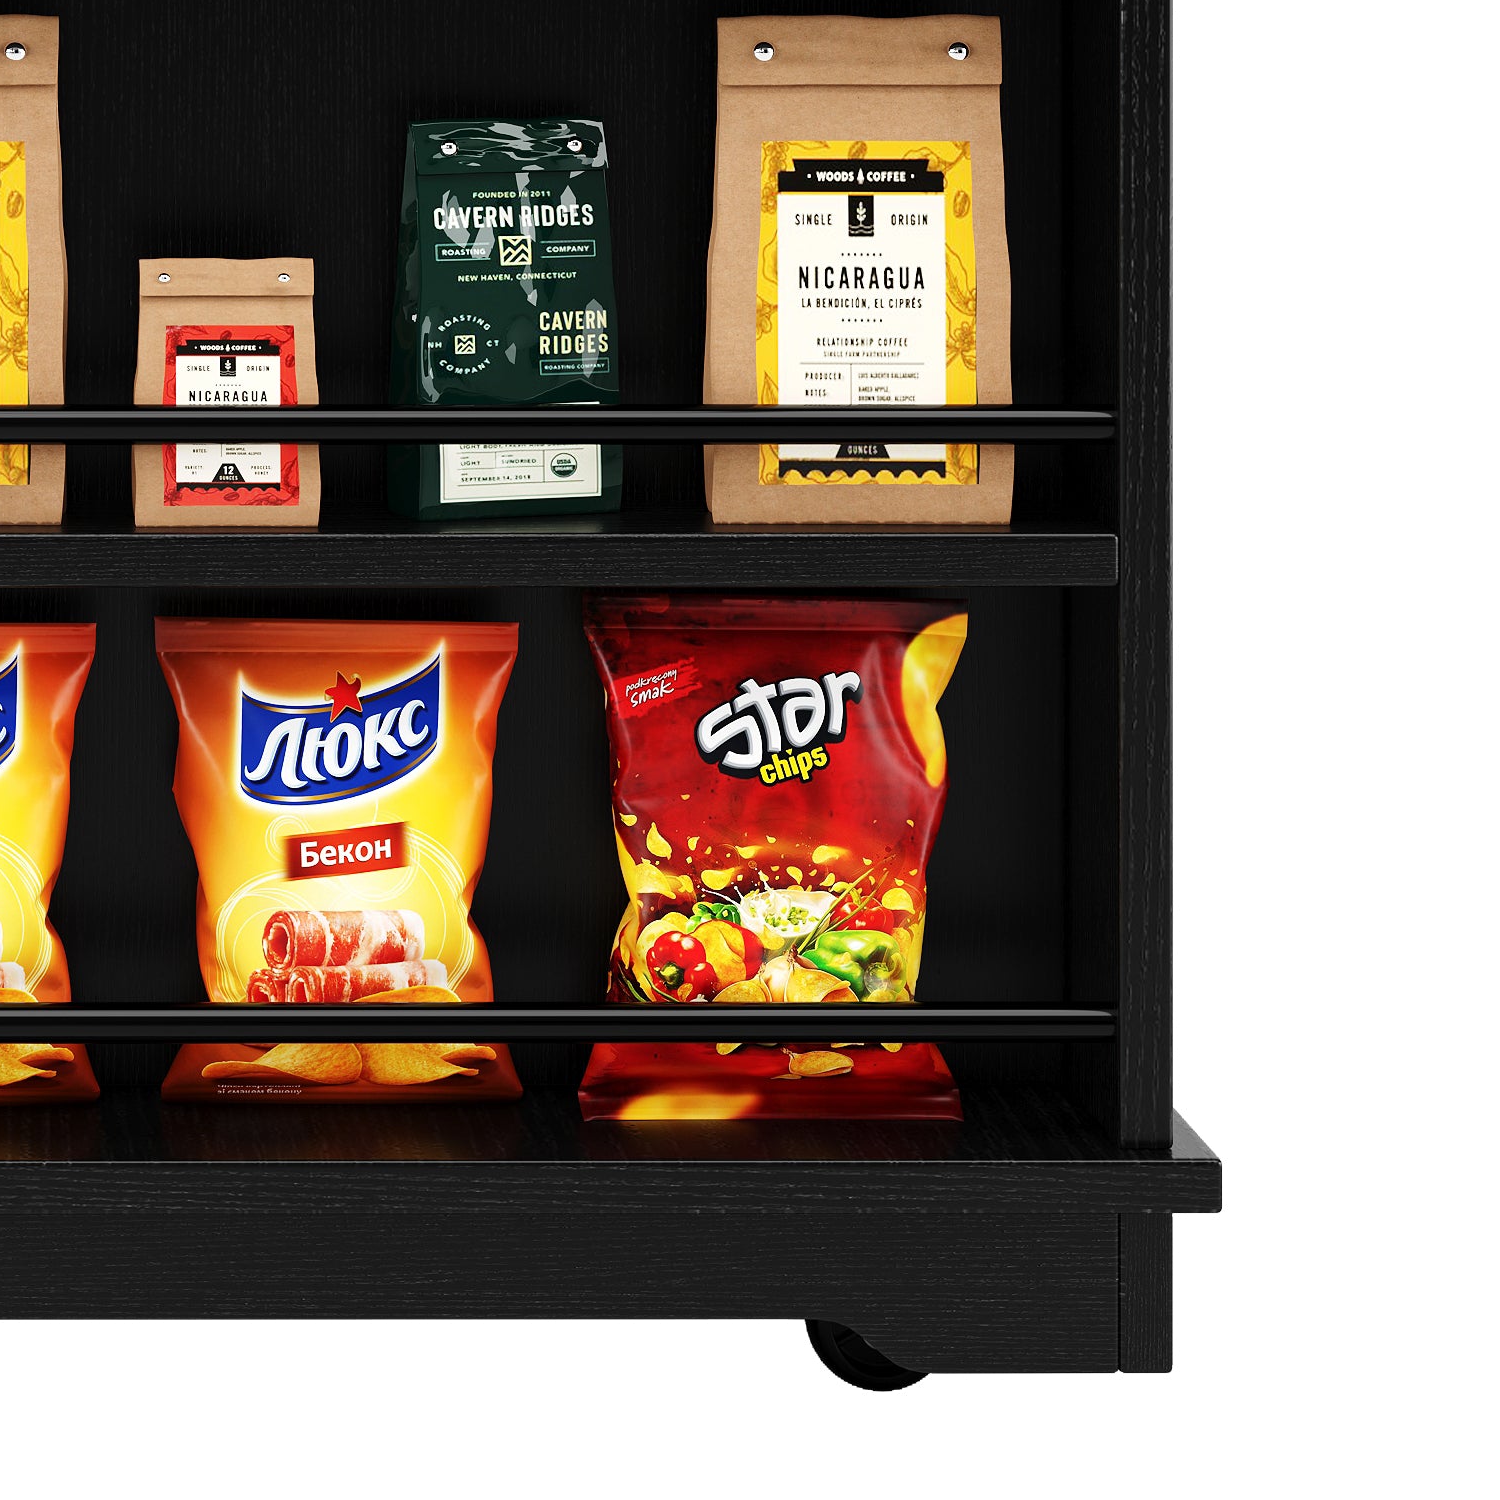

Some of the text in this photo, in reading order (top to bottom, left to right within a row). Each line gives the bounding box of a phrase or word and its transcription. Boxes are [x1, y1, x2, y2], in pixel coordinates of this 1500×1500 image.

[816, 171, 907, 183] WOODS COFFEE
[472, 191, 516, 199] FOUNDED
[530, 190, 551, 198] 2011
[433, 203, 594, 230] CAVERN RIDGES
[795, 214, 833, 226] SINGLE
[891, 214, 929, 226] ORIGIN
[441, 247, 486, 257] ROASTING
[546, 244, 590, 253] COMPANY
[457, 271, 577, 283] NEW HAVEN, CONNECTICUT
[799, 266, 925, 290] NICARAGUA
[801, 298, 812, 308] LA
[874, 298, 884, 308] EL
[888, 297, 922, 309] CIPRÉS
[437, 314, 491, 332] ROASTING
[539, 309, 608, 331] CAVERN
[427, 341, 442, 349] NH
[486, 339, 500, 347] CT
[539, 333, 609, 355] RIDGES
[817, 337, 908, 347] RELATIONSHIP COFFEE
[438, 357, 491, 375] COMPANY
[576, 362, 605, 370] COMPANY
[189, 390, 267, 402] NICARAGUA
[847, 445, 878, 455] OUNCES
[223, 465, 235, 475] 12
[630, 679, 675, 708] smak
[244, 698, 429, 789] Люкс
[760, 745, 828, 785] chips
[300, 836, 392, 870] Бекон
